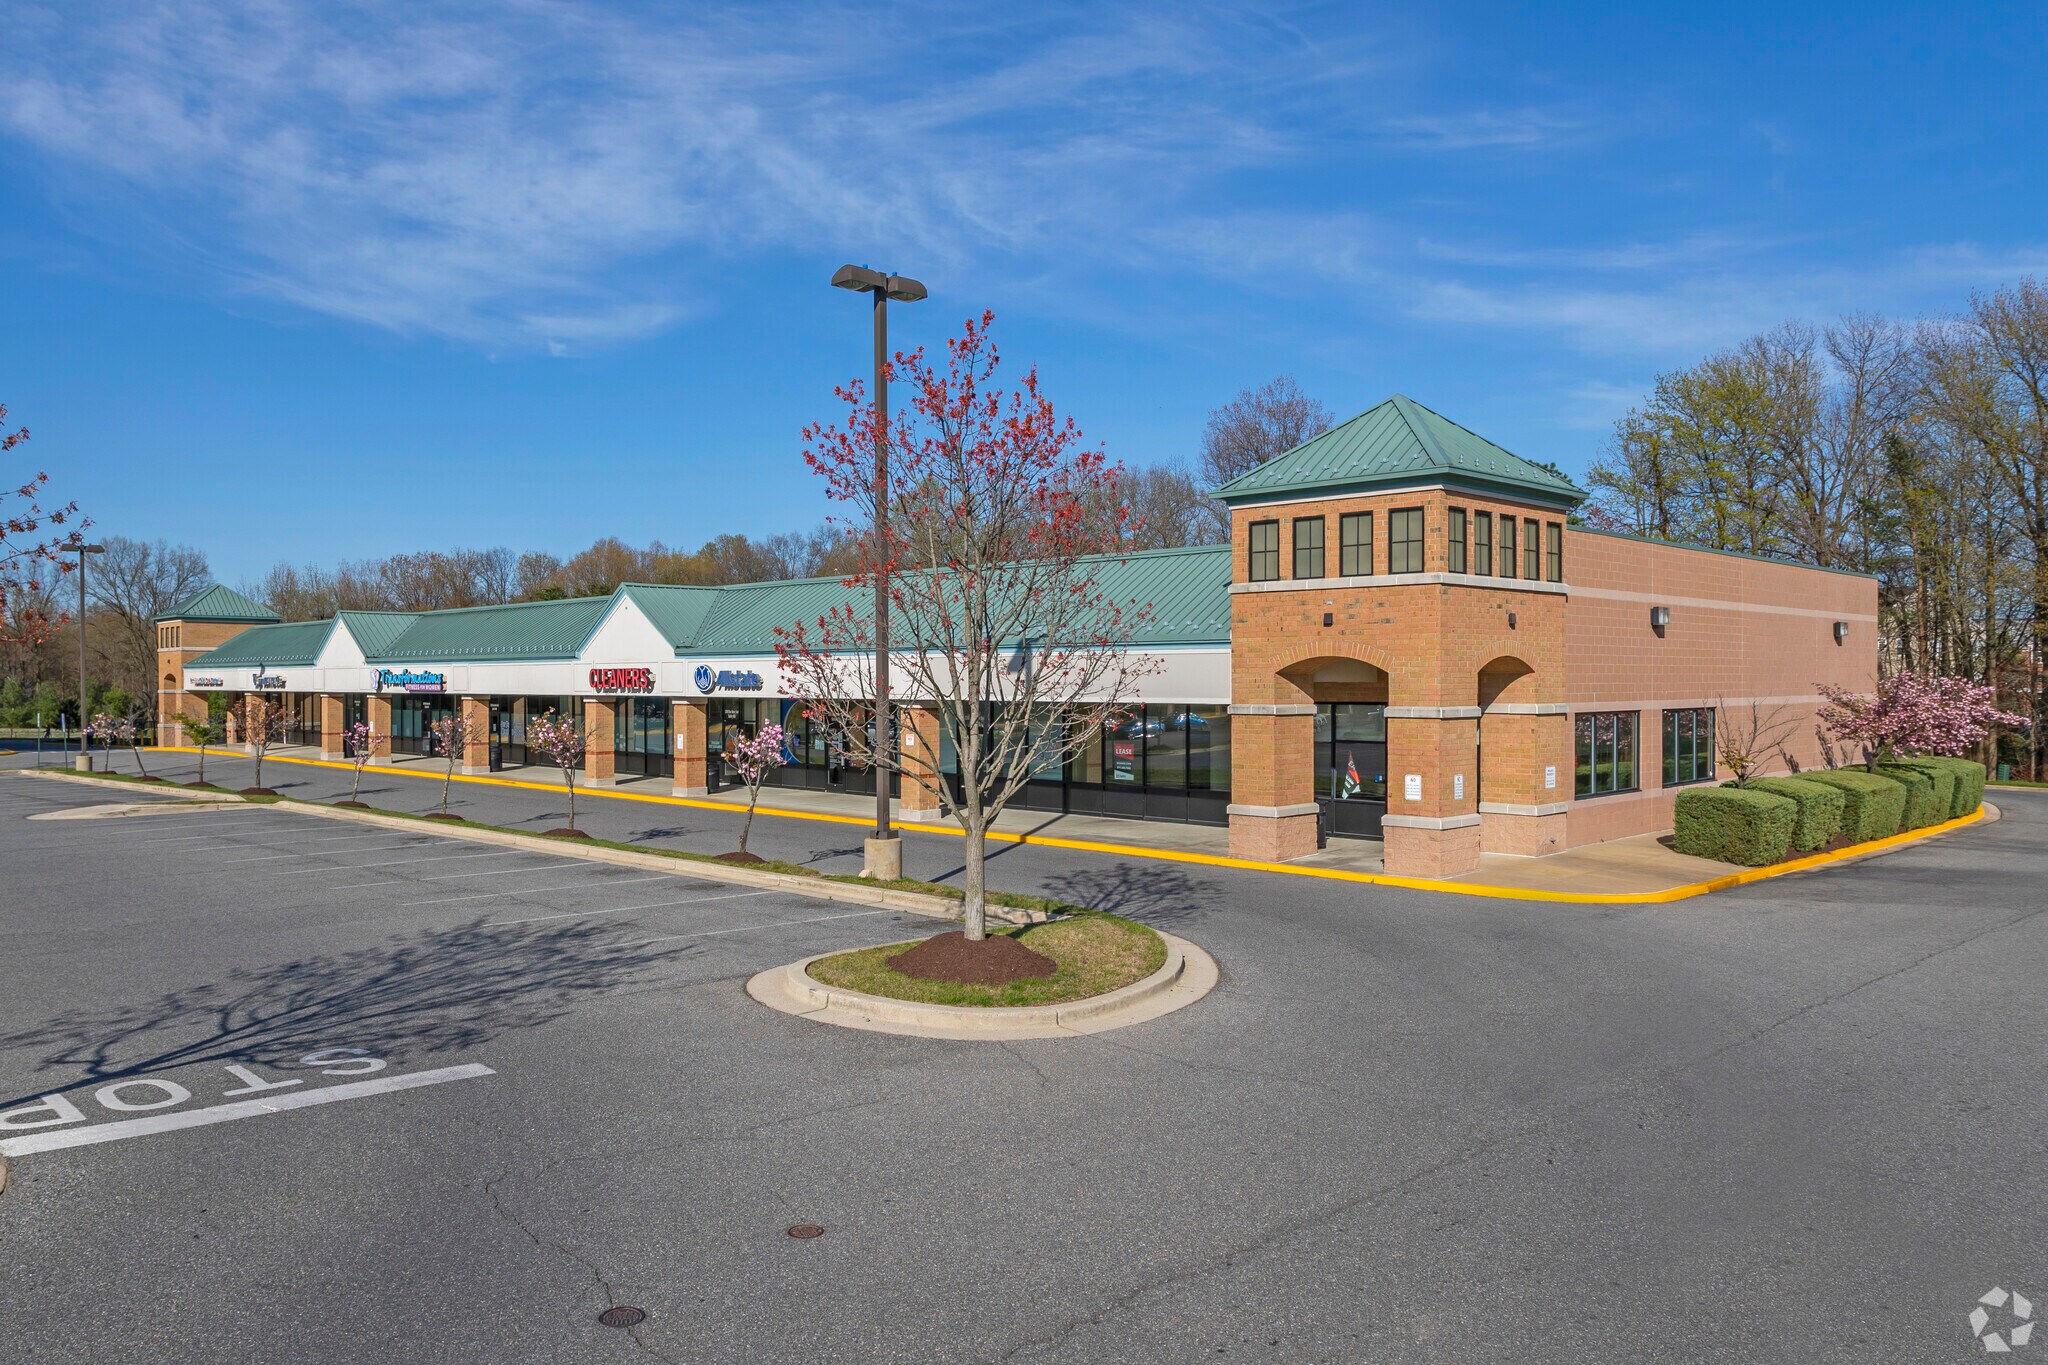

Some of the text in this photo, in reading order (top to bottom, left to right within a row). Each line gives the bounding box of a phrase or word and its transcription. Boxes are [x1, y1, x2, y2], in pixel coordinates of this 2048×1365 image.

[380, 669, 443, 687] Transformations
[589, 668, 649, 689] CLEANERS
[715, 670, 760, 687] Allstate
[0, 1048, 388, 1131] STOP
